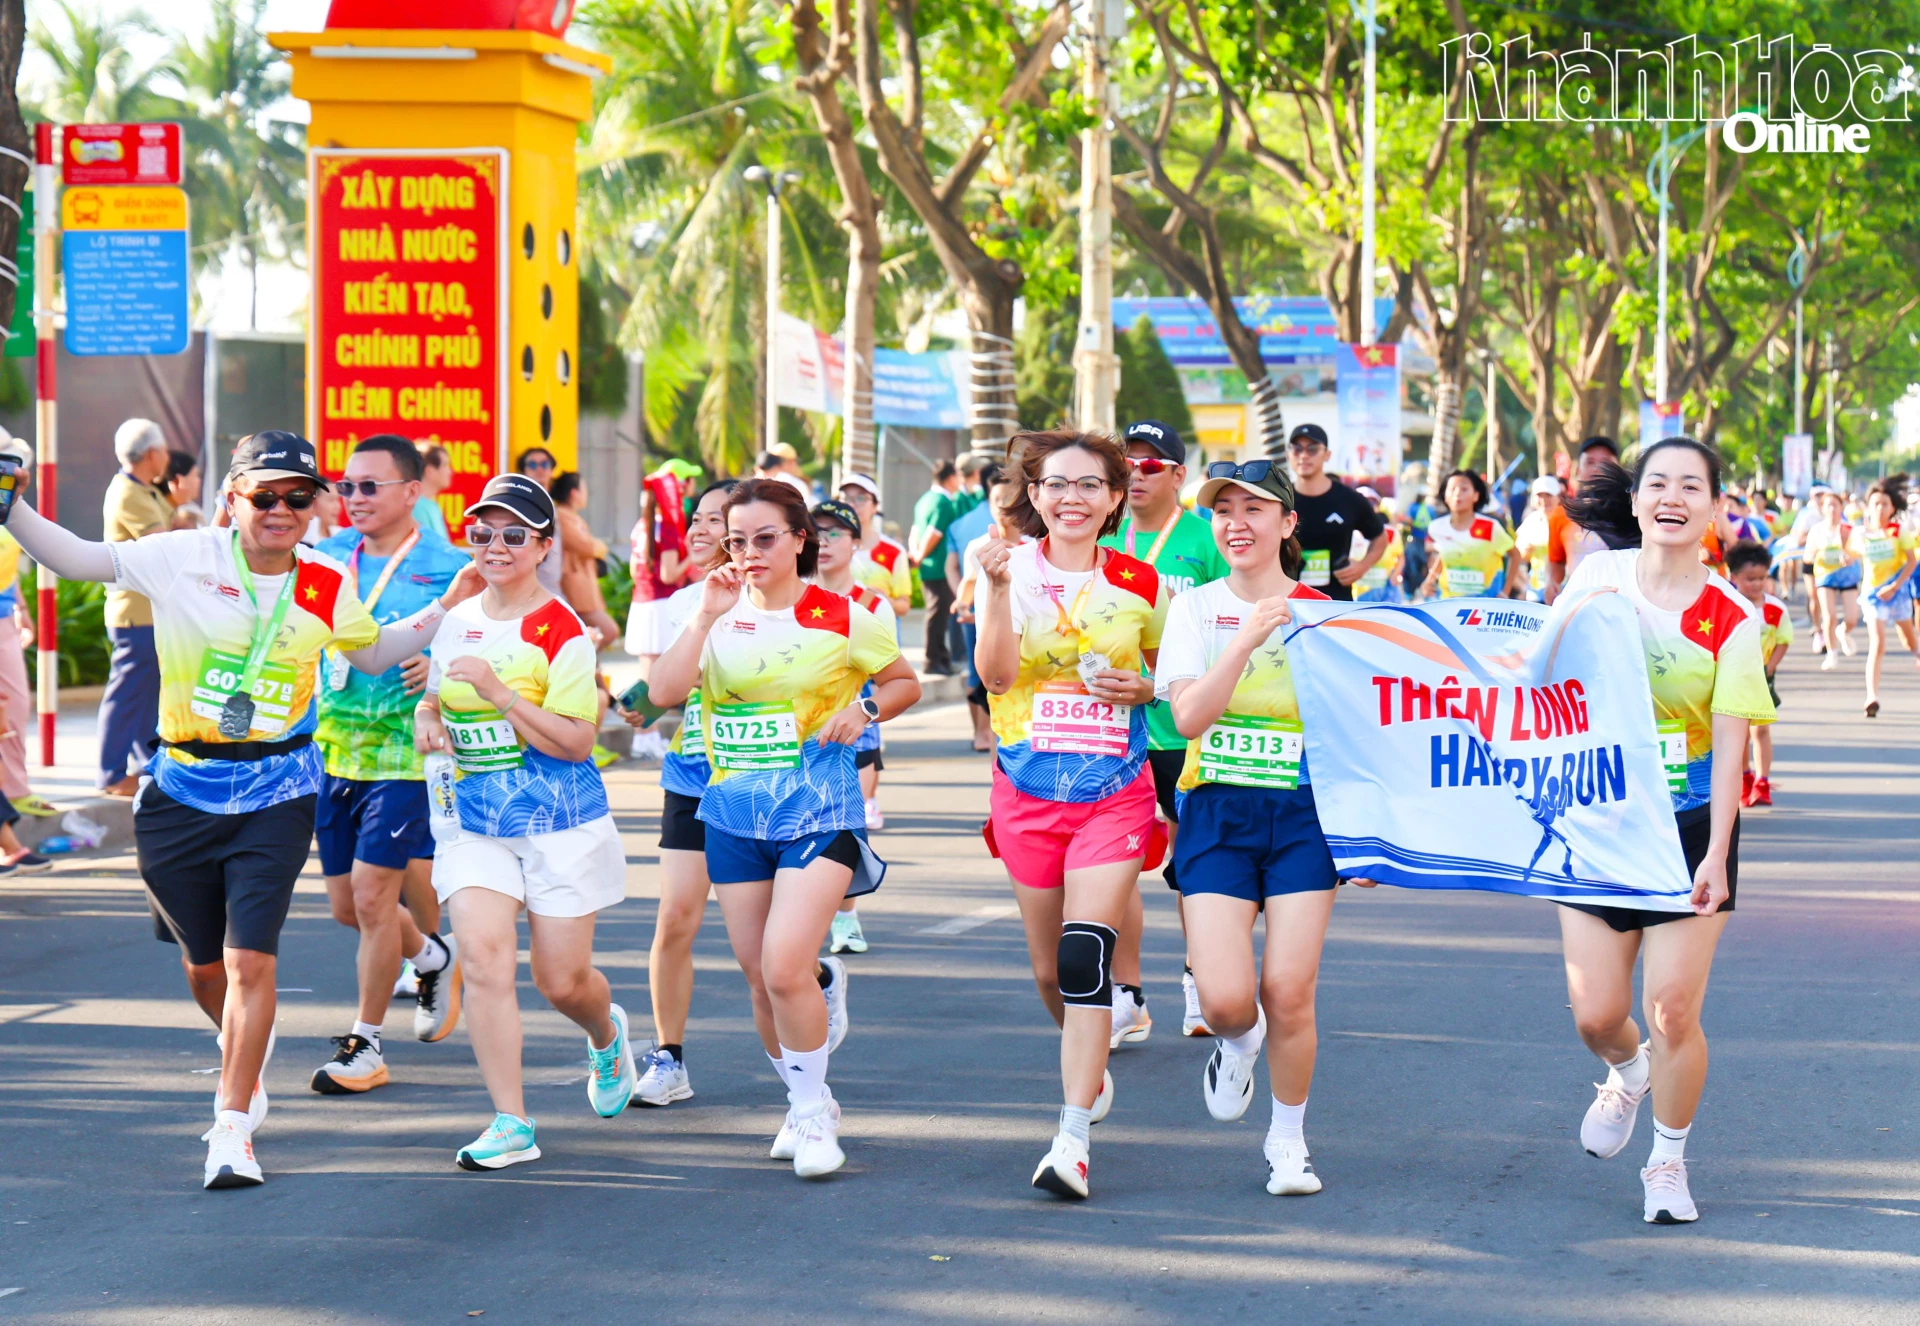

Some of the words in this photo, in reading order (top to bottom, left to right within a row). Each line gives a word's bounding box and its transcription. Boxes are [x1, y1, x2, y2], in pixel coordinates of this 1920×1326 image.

[340, 170, 394, 209] XÂY
[401, 174, 475, 216] DỰNG
[339, 222, 396, 261] NHÀ
[402, 222, 477, 262] NƯỚC
[344, 272, 408, 314] KIẾN
[413, 282, 472, 322] TẠO,
[336, 328, 419, 367] CHÍNH
[425, 325, 480, 368] PHỦ
[326, 380, 392, 419] LIÊM
[398, 381, 489, 424] CHÍNH,
[1129, 424, 1164, 440] USA
[715, 720, 778, 739] 61725
[1040, 700, 1114, 721] 83642
[1510, 678, 1589, 741] LONG
[446, 726, 497, 744] 1811
[1209, 731, 1283, 754] 61313
[442, 772, 454, 818] Revive
[1560, 744, 1626, 807] RUN
